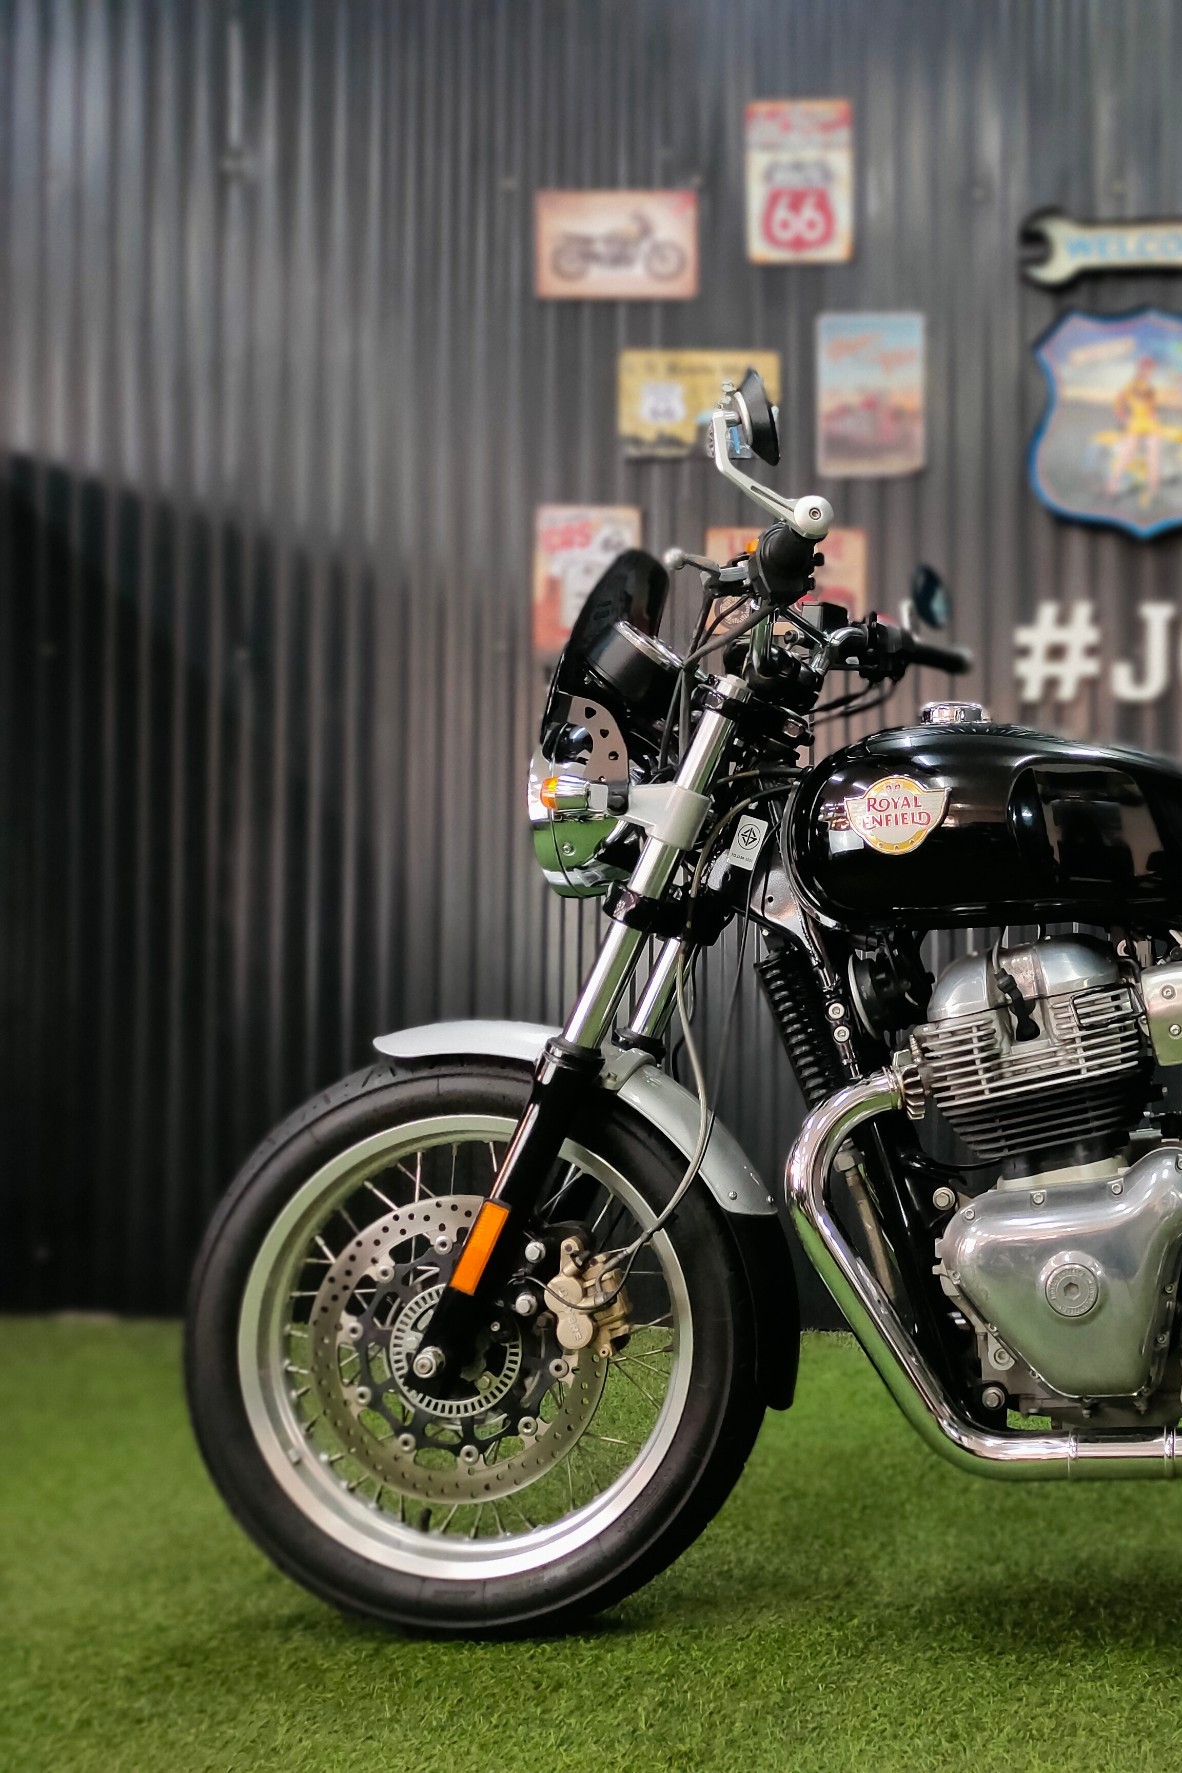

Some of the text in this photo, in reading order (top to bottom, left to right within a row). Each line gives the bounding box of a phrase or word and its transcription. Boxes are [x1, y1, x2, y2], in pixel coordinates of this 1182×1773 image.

[771, 192, 826, 242] 66
[867, 795, 922, 812] ROYAL
[863, 811, 931, 830] ENFIELD
